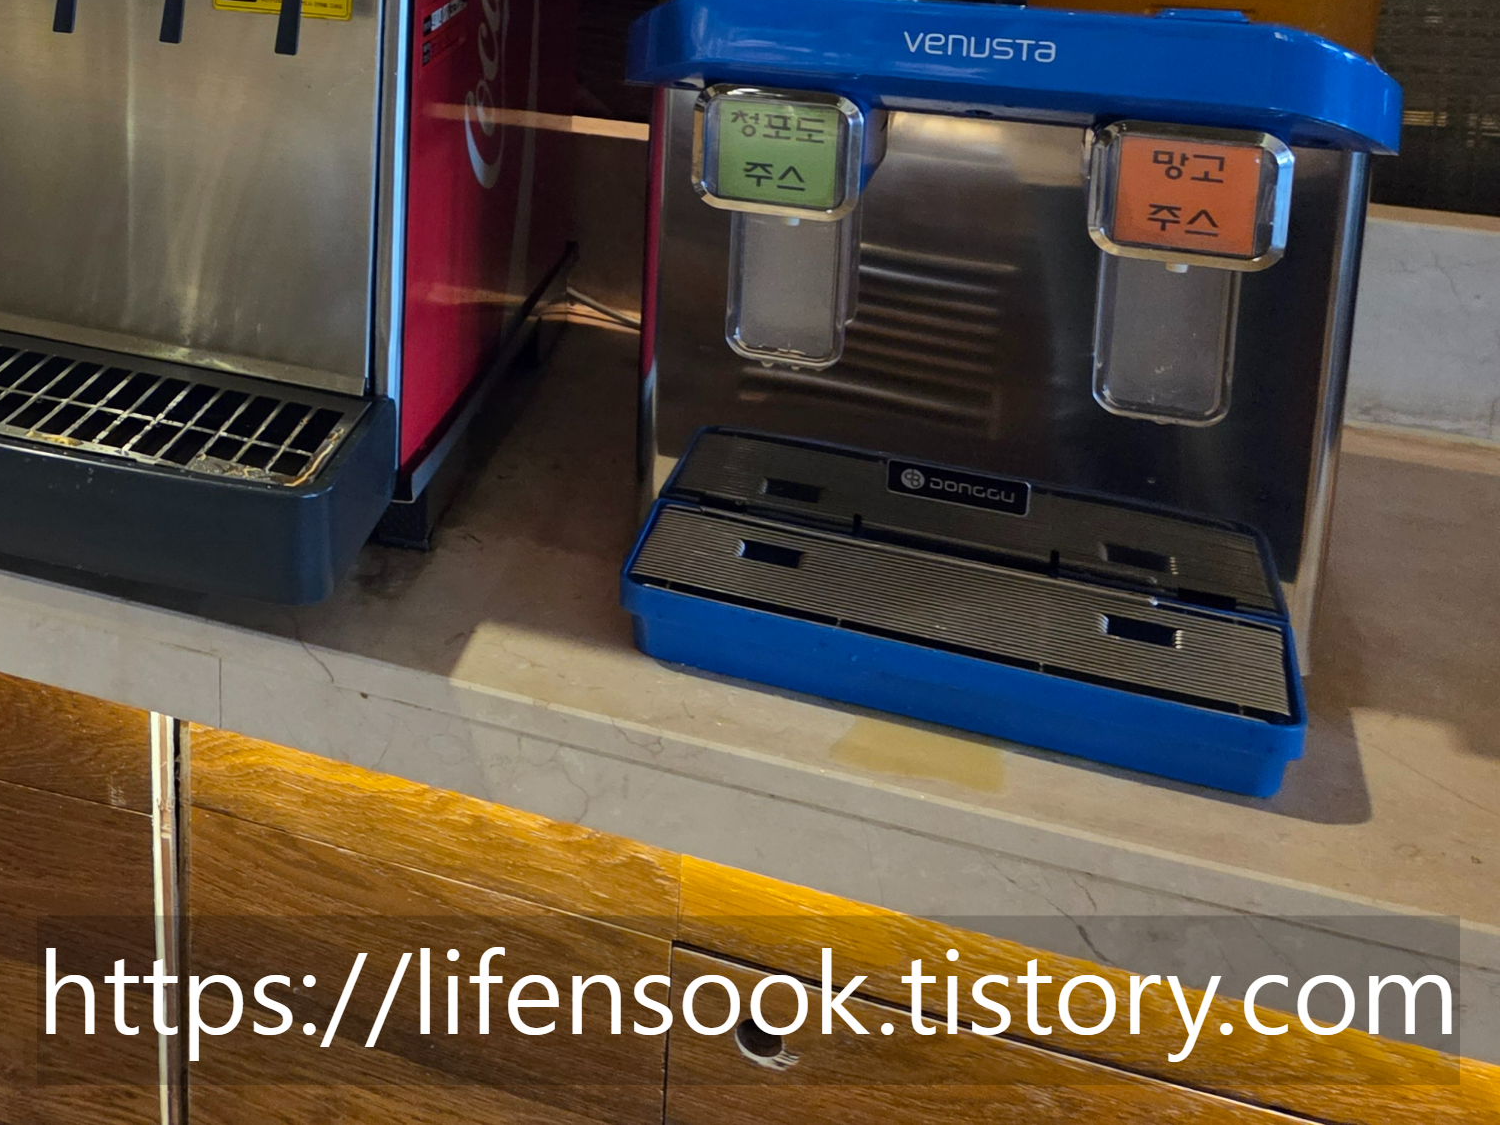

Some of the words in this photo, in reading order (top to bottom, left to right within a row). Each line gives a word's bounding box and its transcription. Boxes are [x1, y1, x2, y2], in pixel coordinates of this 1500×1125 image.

[731, 110, 826, 144] 청포도
[743, 161, 806, 191] 주스
[1152, 150, 1226, 184] 망고
[1147, 203, 1219, 238] 주스
